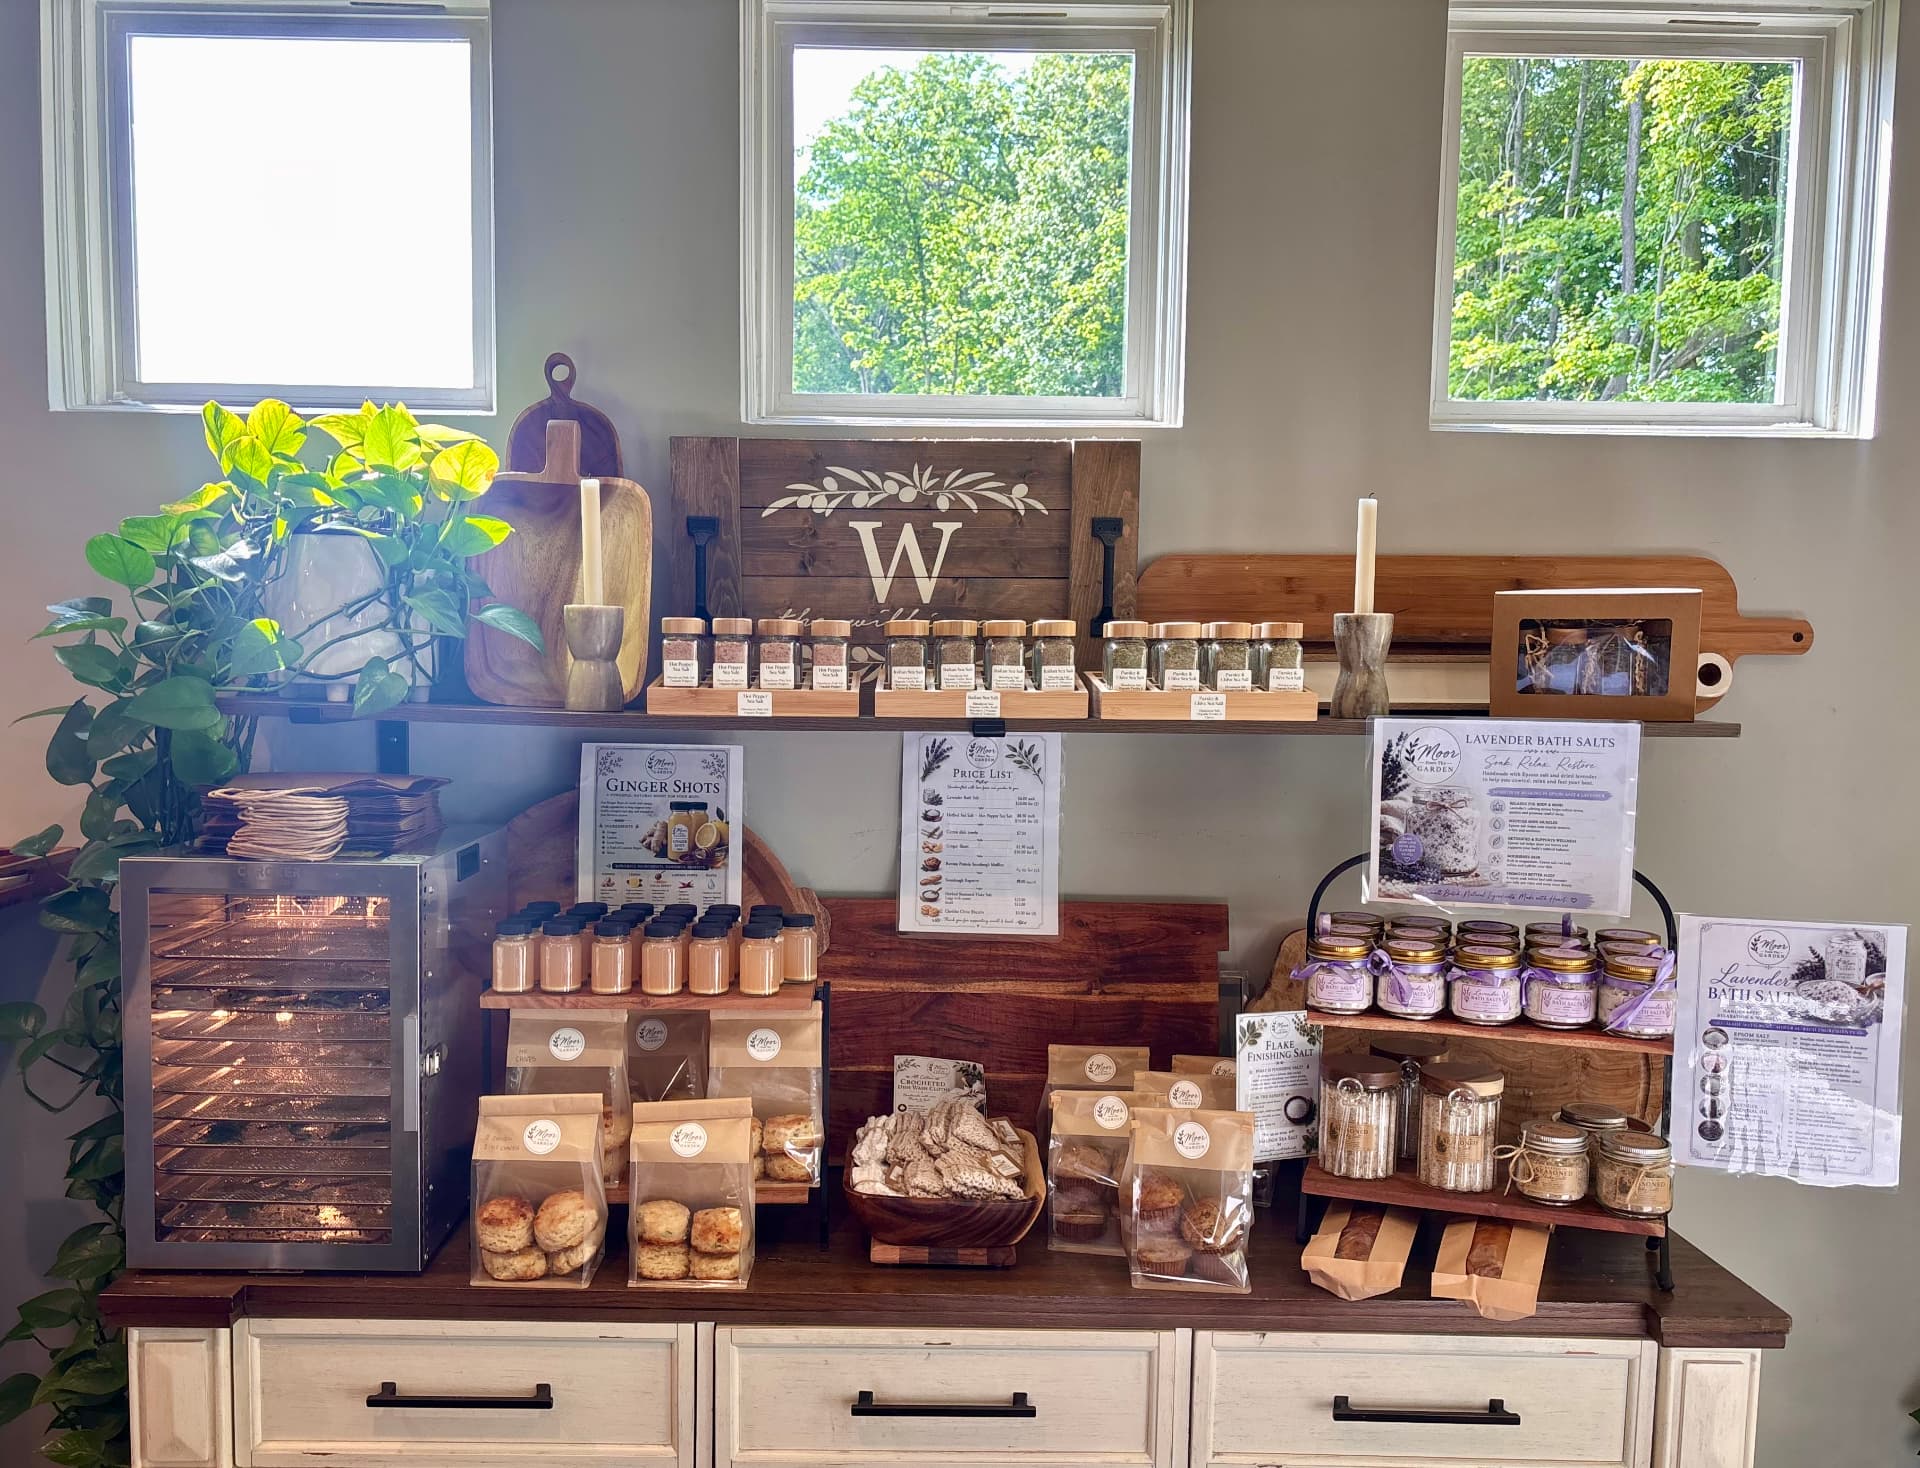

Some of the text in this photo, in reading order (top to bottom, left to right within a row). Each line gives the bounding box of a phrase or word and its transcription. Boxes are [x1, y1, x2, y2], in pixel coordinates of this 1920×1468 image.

[849, 521, 963, 604] W
[1466, 735, 1615, 748] LAVENDER BATH SALTS
[975, 745, 994, 754] Moor
[1418, 743, 1459, 761] Moor
[1484, 755, 1597, 770] Soak Relax Restore
[953, 768, 1013, 779] PRICE LIST
[606, 778, 720, 794] GINGER SHOTS
[1757, 940, 1788, 950] Moor
[1710, 963, 1792, 988] Lavender
[1708, 987, 1750, 1001] BATH
[560, 1034, 580, 1046] Moor
[756, 1036, 777, 1048] Moor
[1266, 1040, 1294, 1050] FLAKE
[1247, 1048, 1314, 1062] FINISHING SALT
[1094, 1063, 1112, 1072] Moor
[900, 1079, 946, 1087] CROCHETED
[1178, 1090, 1198, 1100] Moor
[1103, 1105, 1123, 1115] Moor
[536, 1127, 556, 1138] Moor
[681, 1130, 703, 1141] Moor
[1184, 1132, 1205, 1143] Moor
